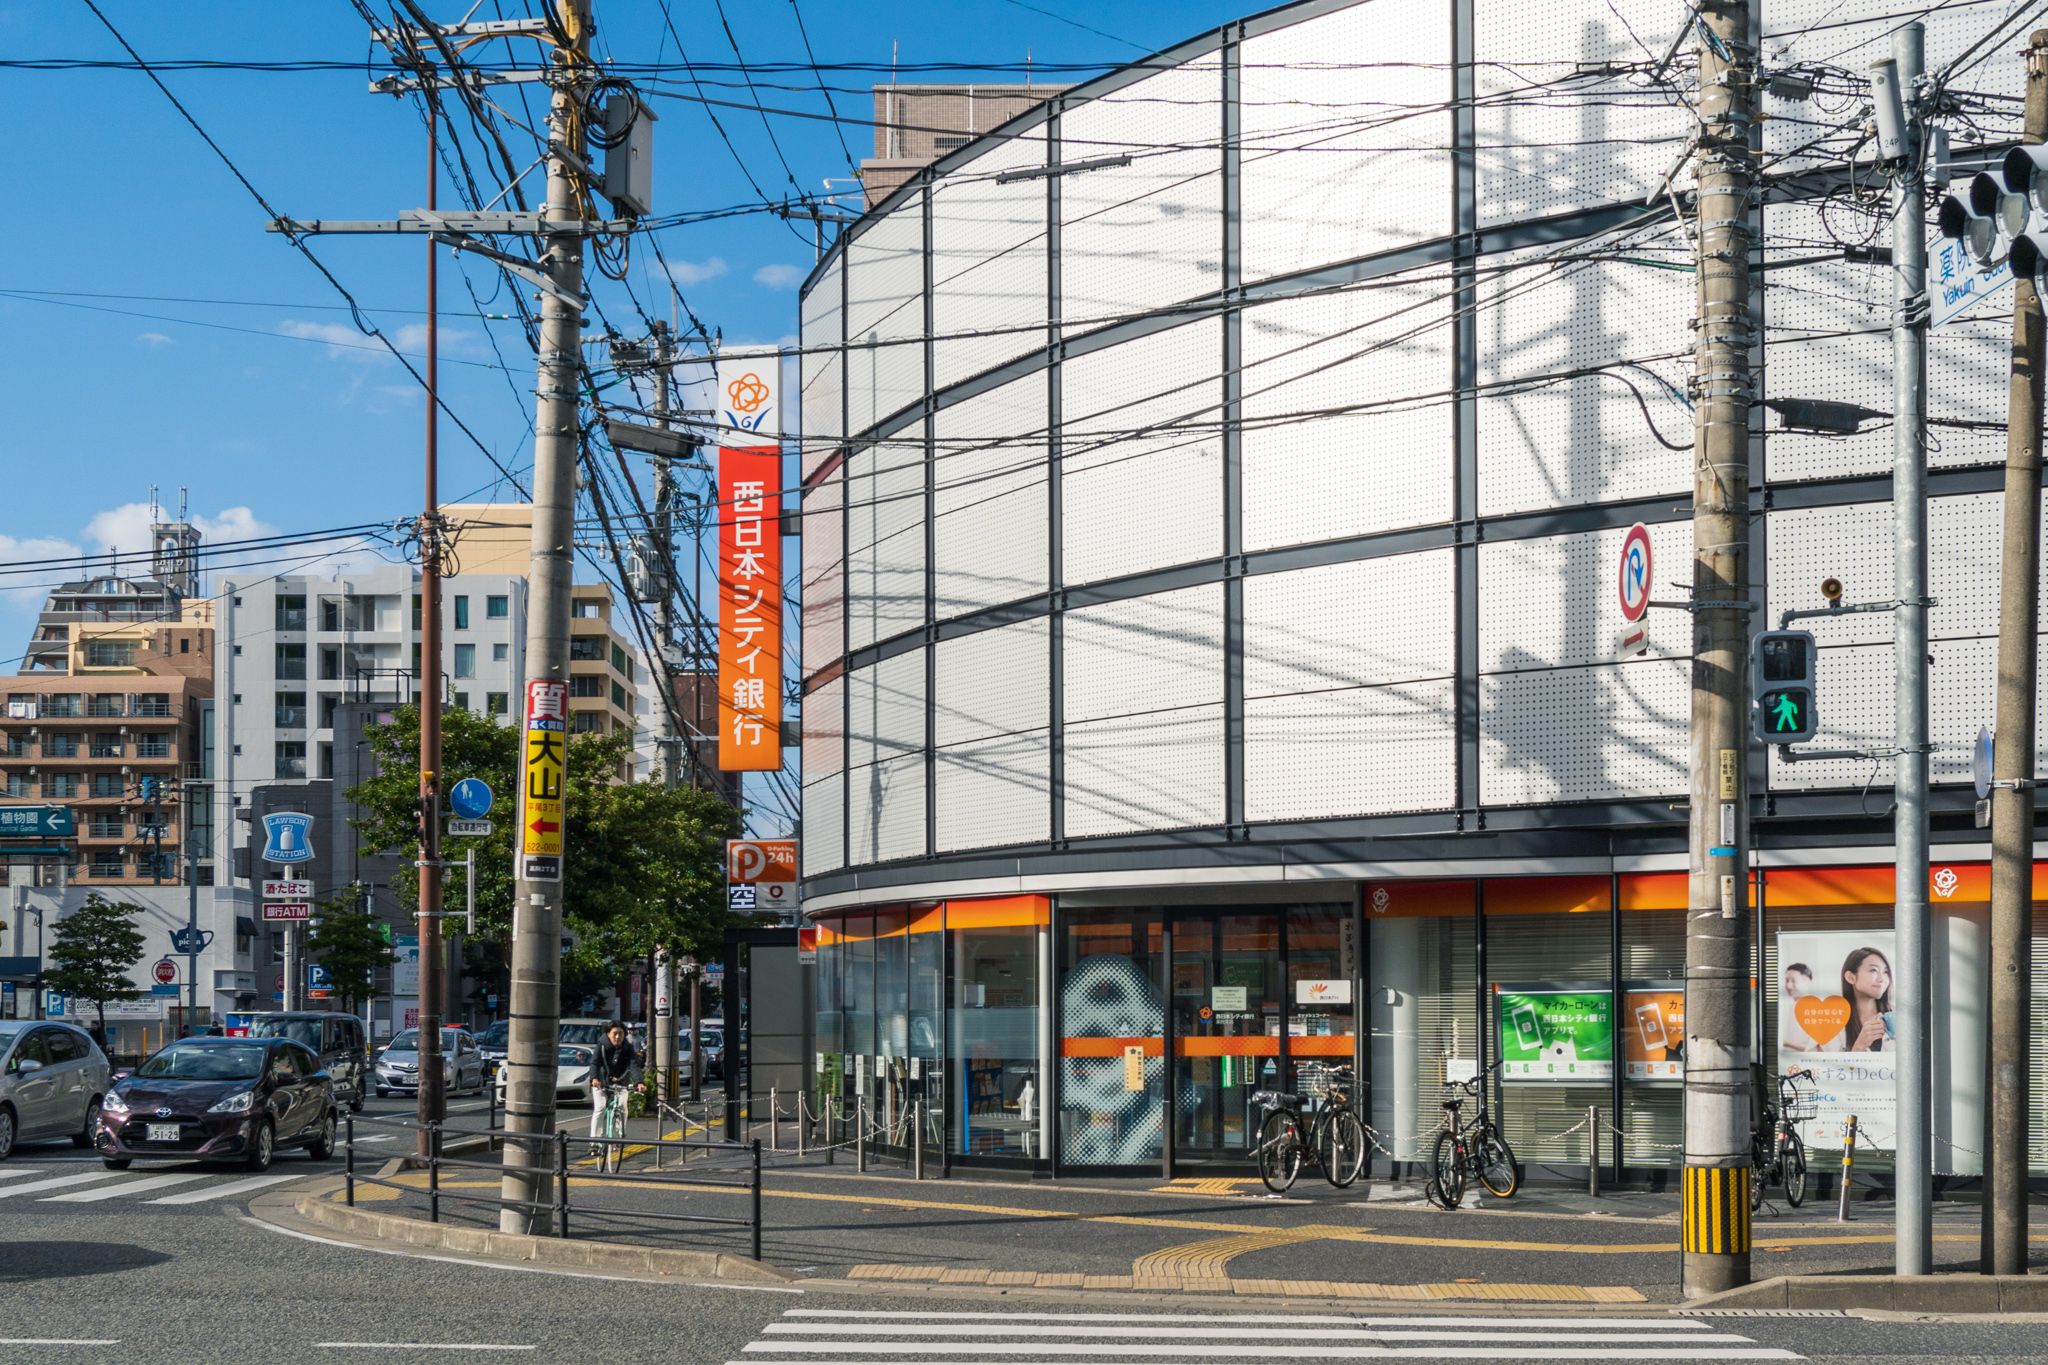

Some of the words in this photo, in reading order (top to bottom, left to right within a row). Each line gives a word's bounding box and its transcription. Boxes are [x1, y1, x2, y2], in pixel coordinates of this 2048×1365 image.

[1943, 277, 1975, 307] Yakuin
[733, 481, 765, 746] 西日本シティ銀行
[531, 683, 565, 720] 質
[529, 732, 563, 800] 大山
[527, 803, 561, 813] 平尾3丁目
[1, 812, 38, 824] 植物園
[269, 818, 306, 826] LAWSON
[527, 843, 560, 852] 522-0001
[269, 849, 306, 858] STATION
[768, 852, 794, 863] 24h
[266, 906, 306, 917] 銀行ATM
[313, 968, 323, 983] P
[49, 994, 62, 1013] P
[1543, 1001, 1607, 1010] マイカーローンは
[1542, 1014, 1607, 1023] 西日本シティ銀行
[1543, 1026, 1578, 1035] アプリで。
[155, 1131, 178, 1140] 51-29
